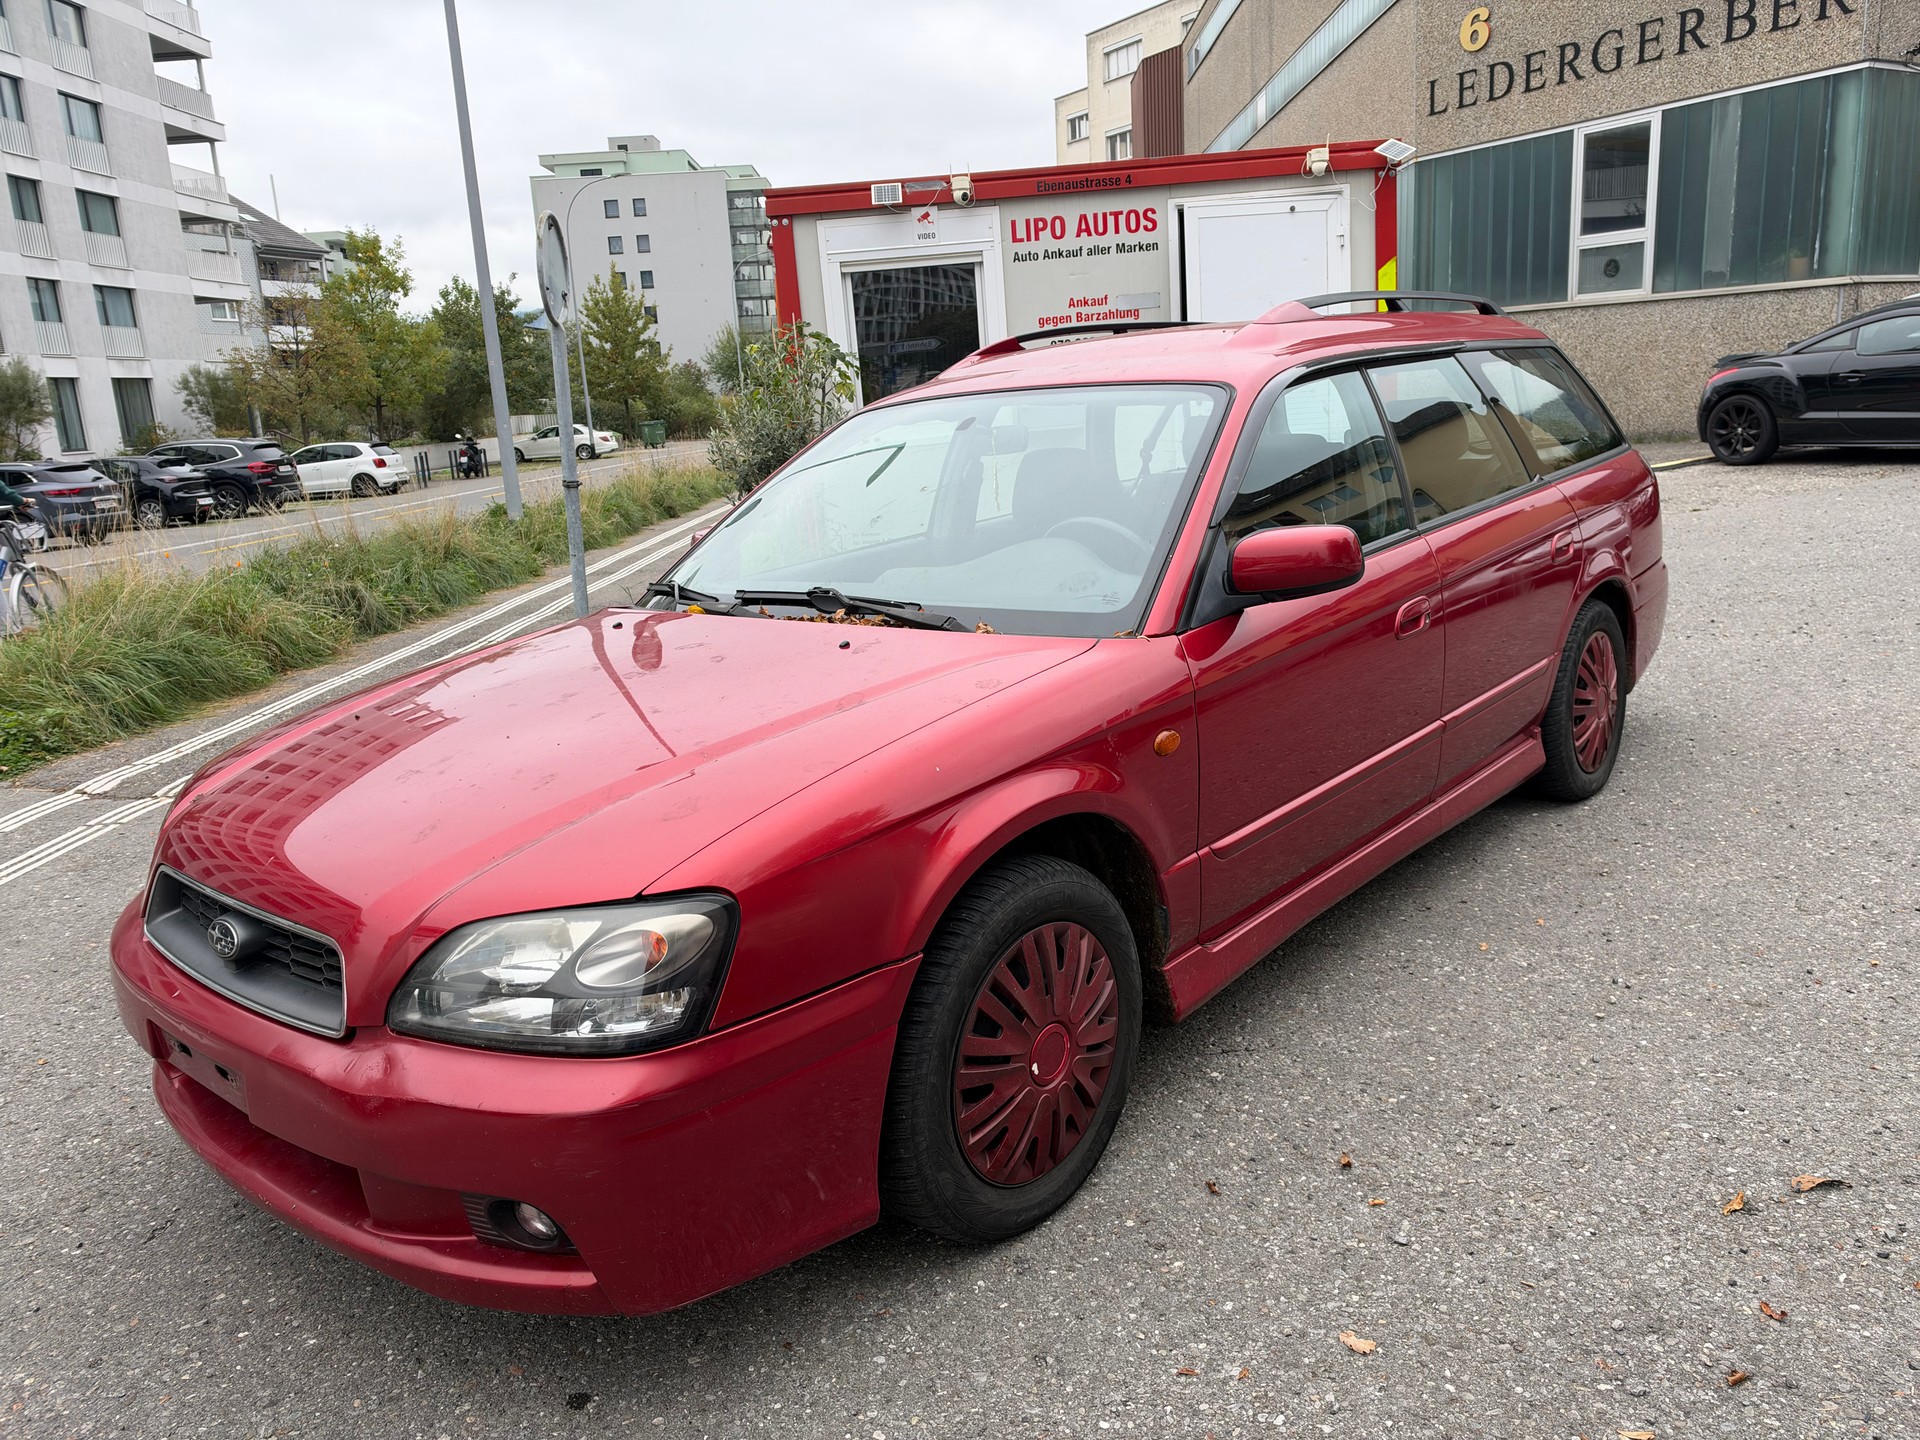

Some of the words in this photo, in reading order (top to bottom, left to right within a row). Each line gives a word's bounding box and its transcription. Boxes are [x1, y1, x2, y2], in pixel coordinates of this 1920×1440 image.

[1460, 6, 1492, 52] 6
[1036, 178, 1122, 193] Ebenaustrasse
[1124, 174, 1133, 185] 4
[1011, 214, 1067, 244] LIPO
[1075, 208, 1158, 239] AUTOS
[917, 232, 936, 240] VIDEO
[1012, 251, 1039, 262] Auto
[1042, 248, 1082, 261] Ankauf
[1086, 244, 1112, 257] aller
[1115, 242, 1159, 255] Marken
[1068, 295, 1109, 309] Ankauf
[1038, 315, 1072, 328] gegen
[1076, 309, 1140, 323] Barzahlung
